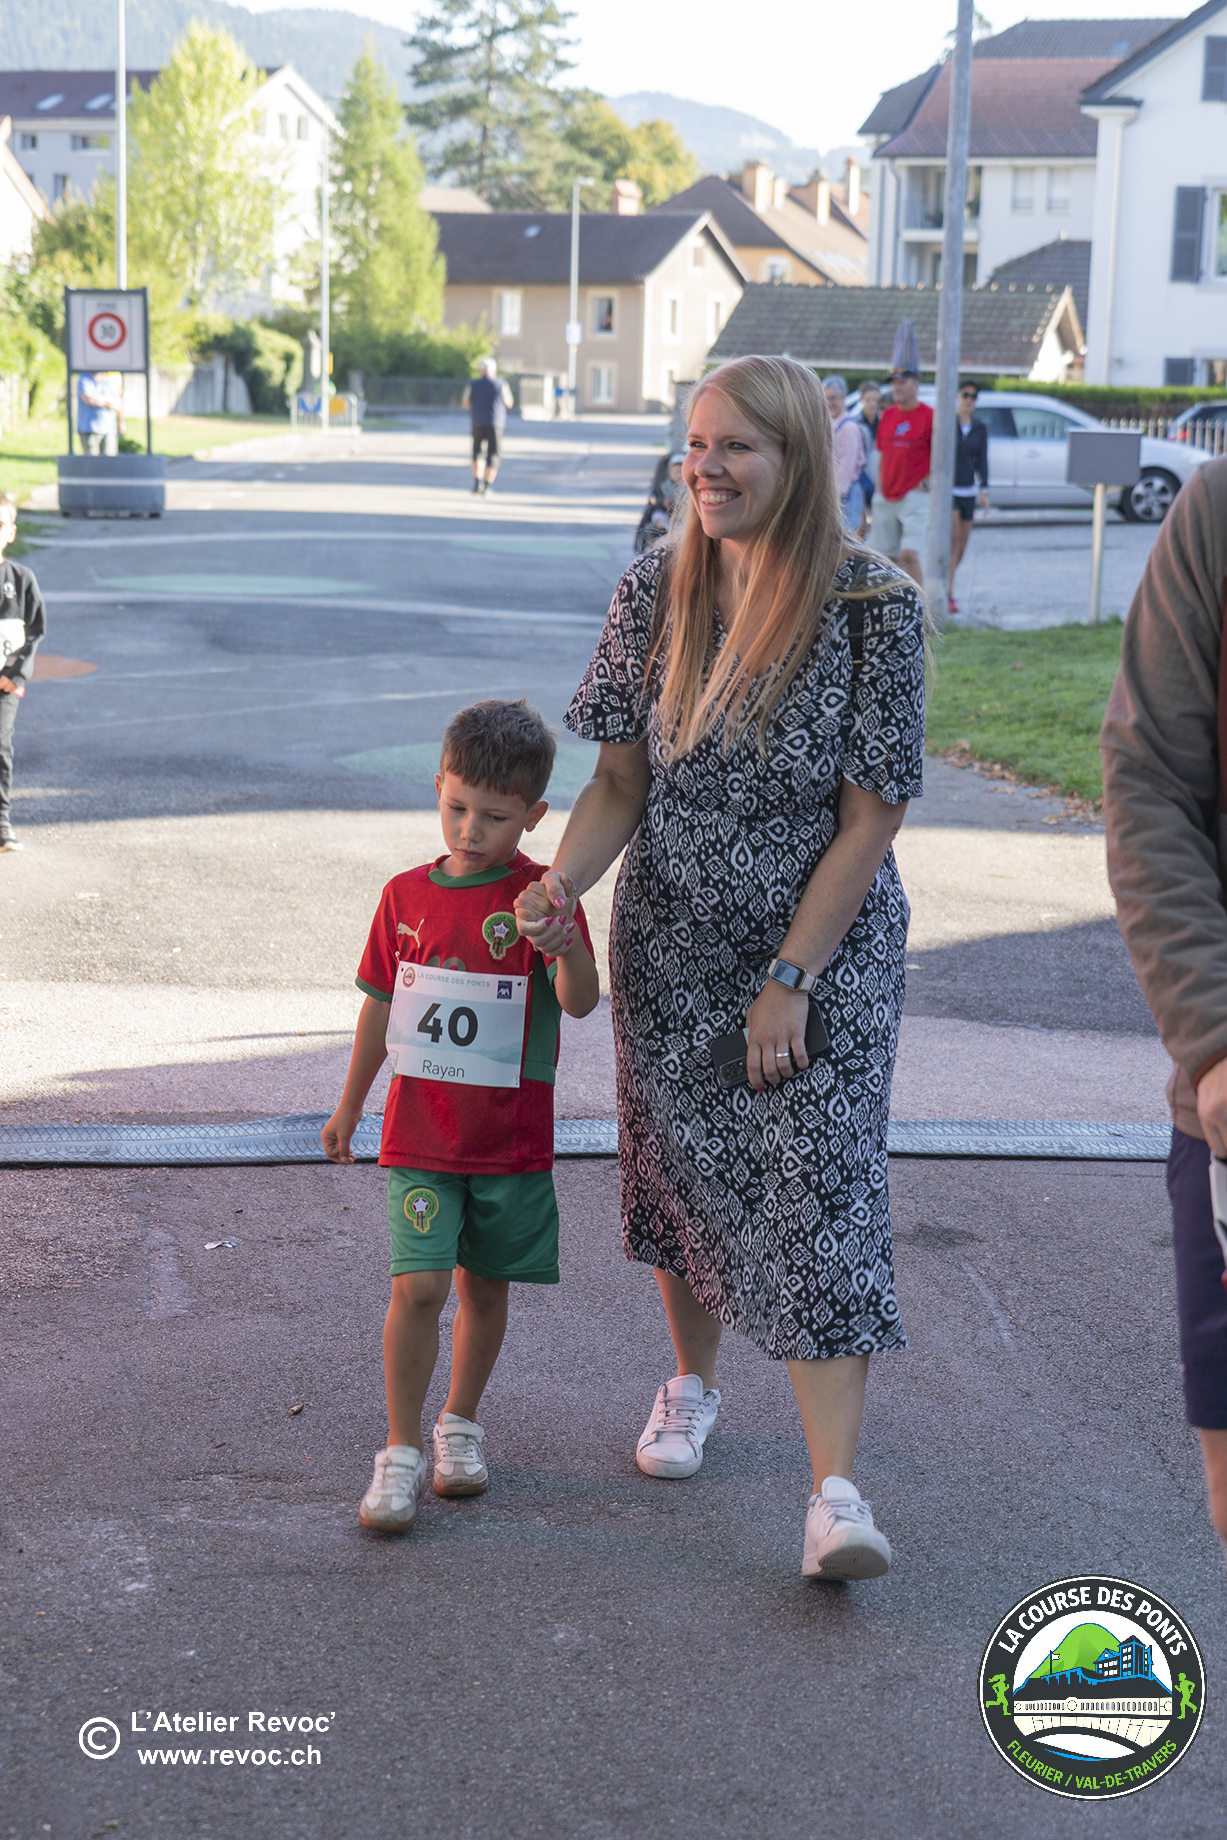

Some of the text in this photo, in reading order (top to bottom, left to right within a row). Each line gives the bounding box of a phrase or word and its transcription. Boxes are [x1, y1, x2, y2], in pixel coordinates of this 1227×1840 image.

[100, 324, 116, 340] 30
[416, 971, 425, 979] LA
[425, 973, 450, 984] COURSE
[450, 977, 465, 986] DES
[466, 979, 491, 988] PONTS
[416, 1002, 479, 1047] 40
[422, 1059, 465, 1079] Rayan
